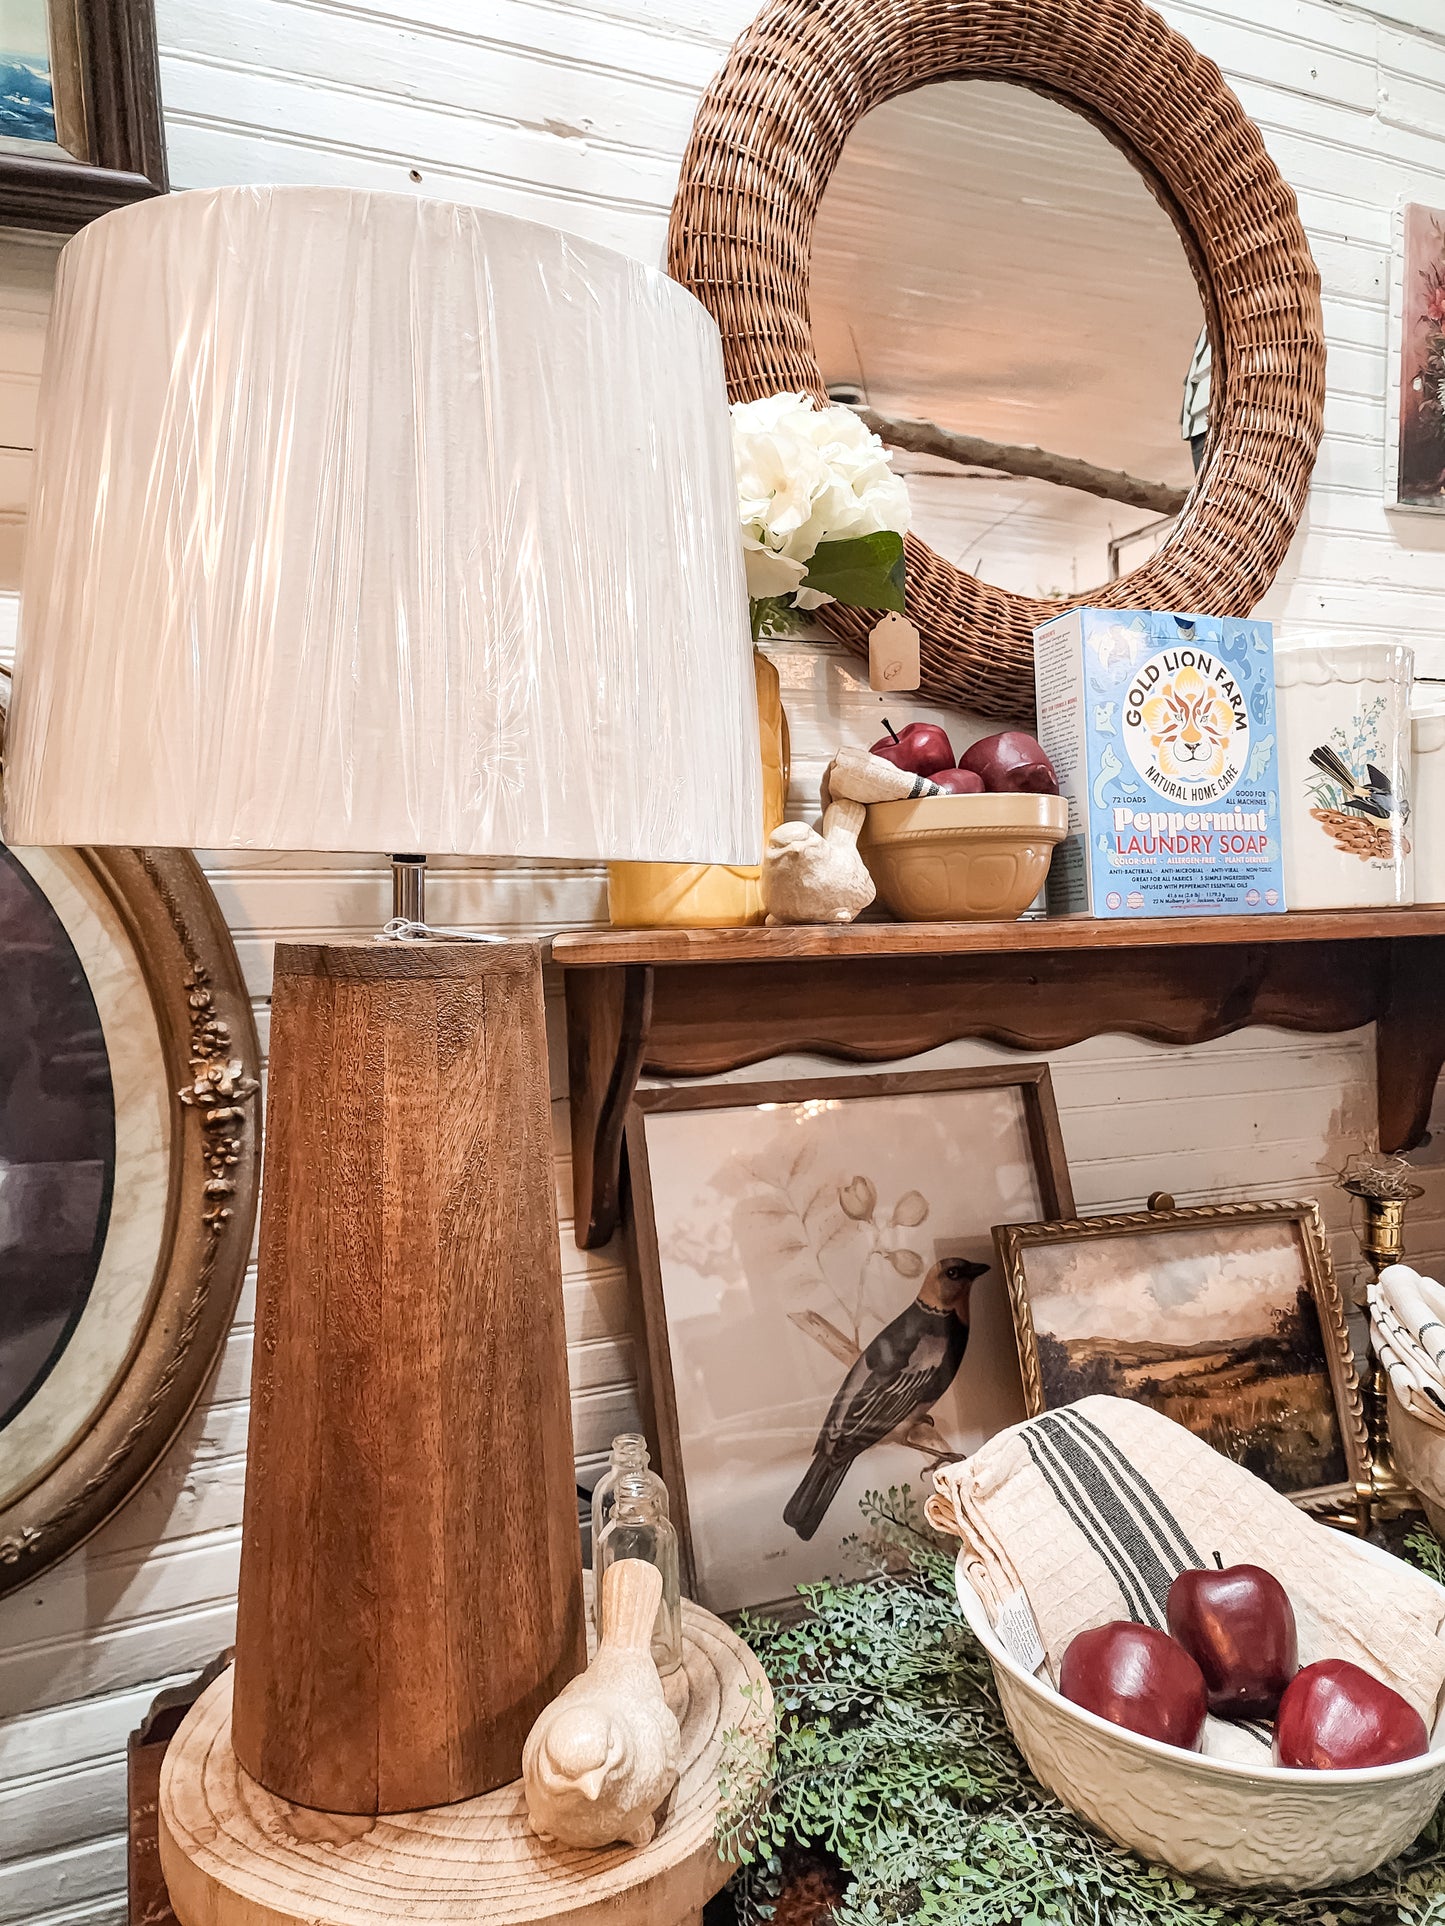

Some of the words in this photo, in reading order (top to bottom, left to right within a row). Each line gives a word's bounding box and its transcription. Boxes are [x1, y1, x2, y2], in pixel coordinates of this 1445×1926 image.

[1126, 665, 1160, 727] GOLD
[1163, 651, 1212, 674] LION
[1215, 667, 1248, 731] FARM
[1145, 765, 1187, 800] NATURAL
[1191, 784, 1218, 802] HOME
[1217, 763, 1239, 790] CARE
[1112, 796, 1121, 804] 72
[1123, 796, 1147, 804] LOADS
[1112, 805, 1268, 838] Peppermint
[1116, 835, 1214, 855] LAUNDRY
[1219, 834, 1268, 854] SOAP
[1114, 857, 1157, 866] COLOR-SAFE
[1167, 856, 1216, 865] ALLERGEN-FREE
